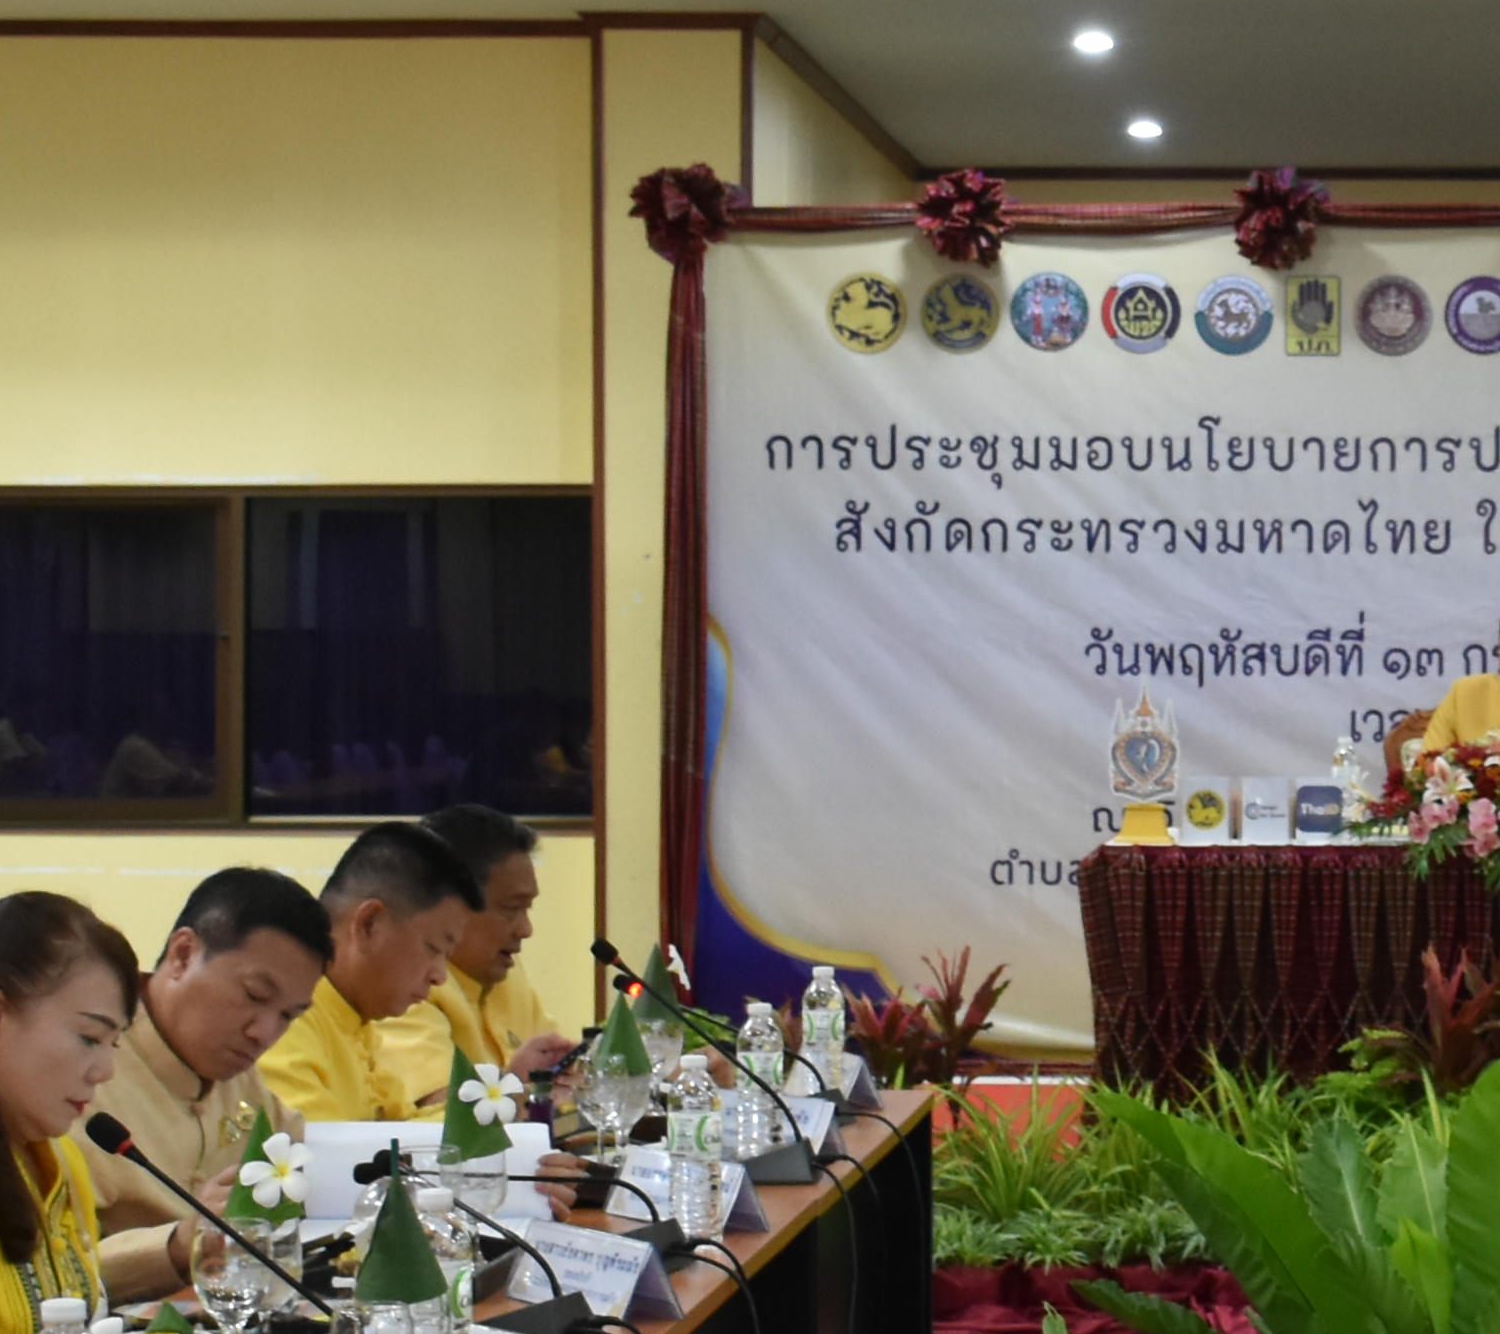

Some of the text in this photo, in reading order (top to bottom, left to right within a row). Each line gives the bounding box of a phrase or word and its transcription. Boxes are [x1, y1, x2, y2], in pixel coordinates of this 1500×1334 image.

[835, 499, 1452, 556] สังกัดกระทรวงมหาดไทย
[1084, 611, 1365, 688] วันพฤหัสบดีที่
[1382, 646, 1444, 680] ๑๓
